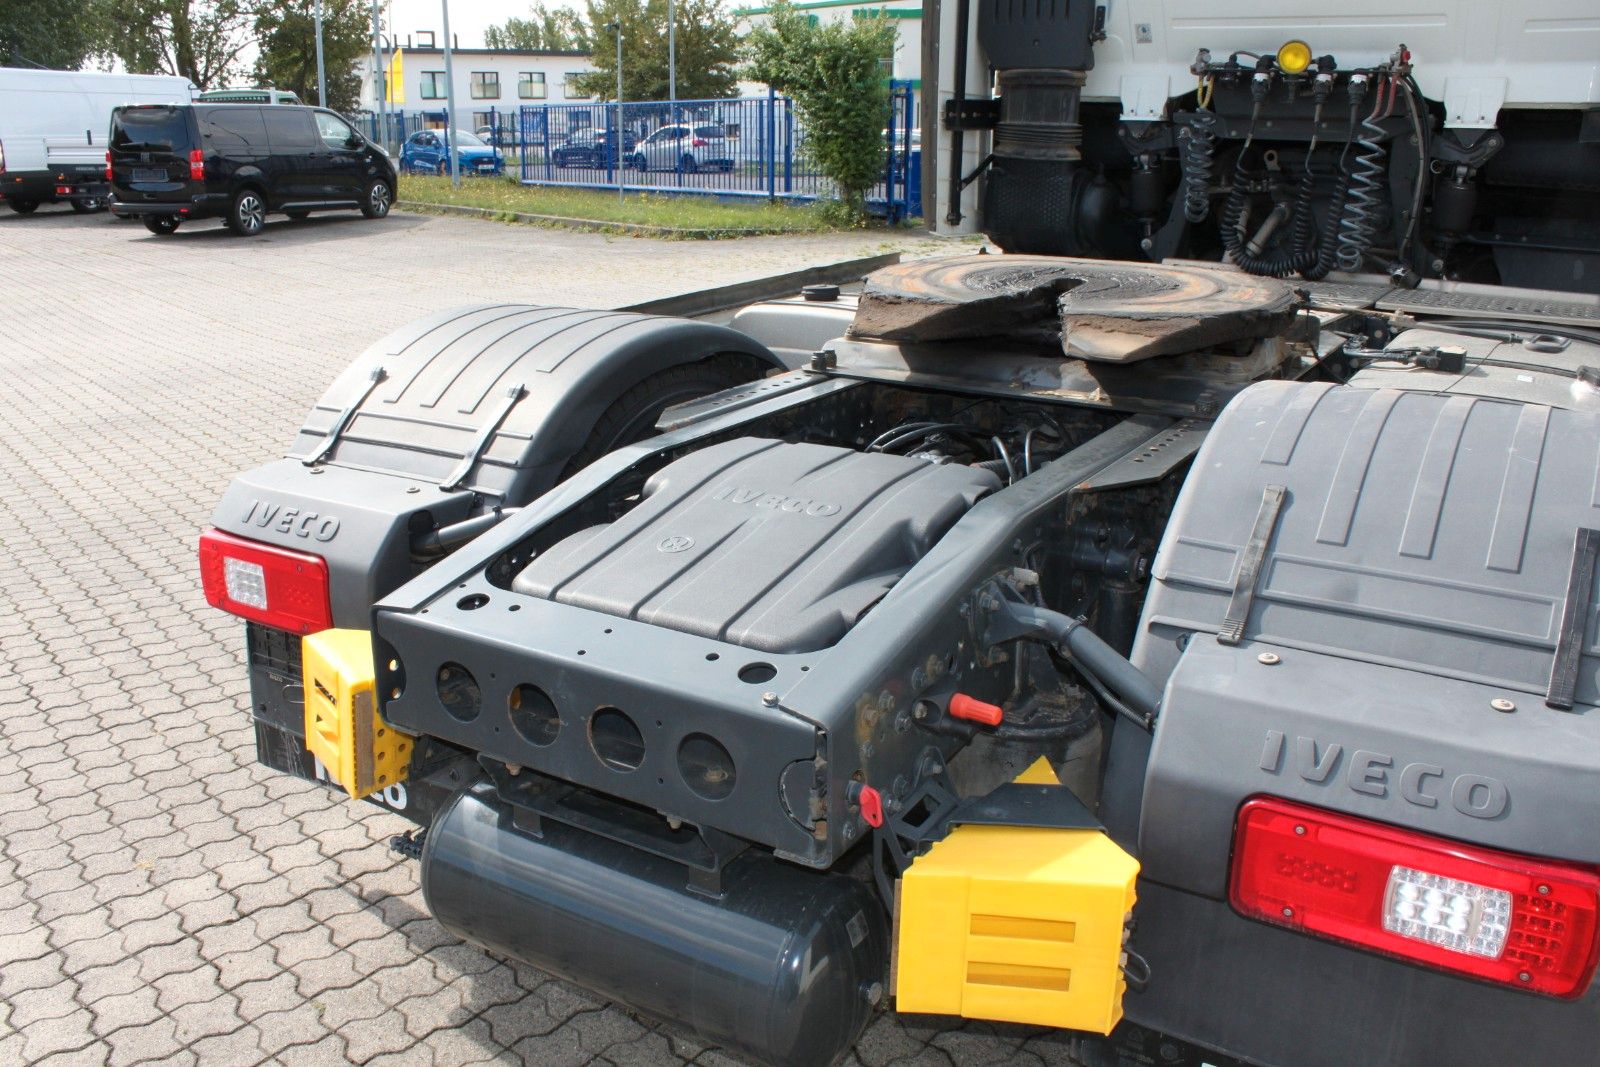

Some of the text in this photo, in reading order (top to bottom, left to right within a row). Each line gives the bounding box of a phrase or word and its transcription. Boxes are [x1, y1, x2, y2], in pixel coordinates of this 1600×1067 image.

[241, 499, 341, 543] IVECO
[713, 486, 842, 517] IVECO
[1258, 729, 1511, 820] IVECO
